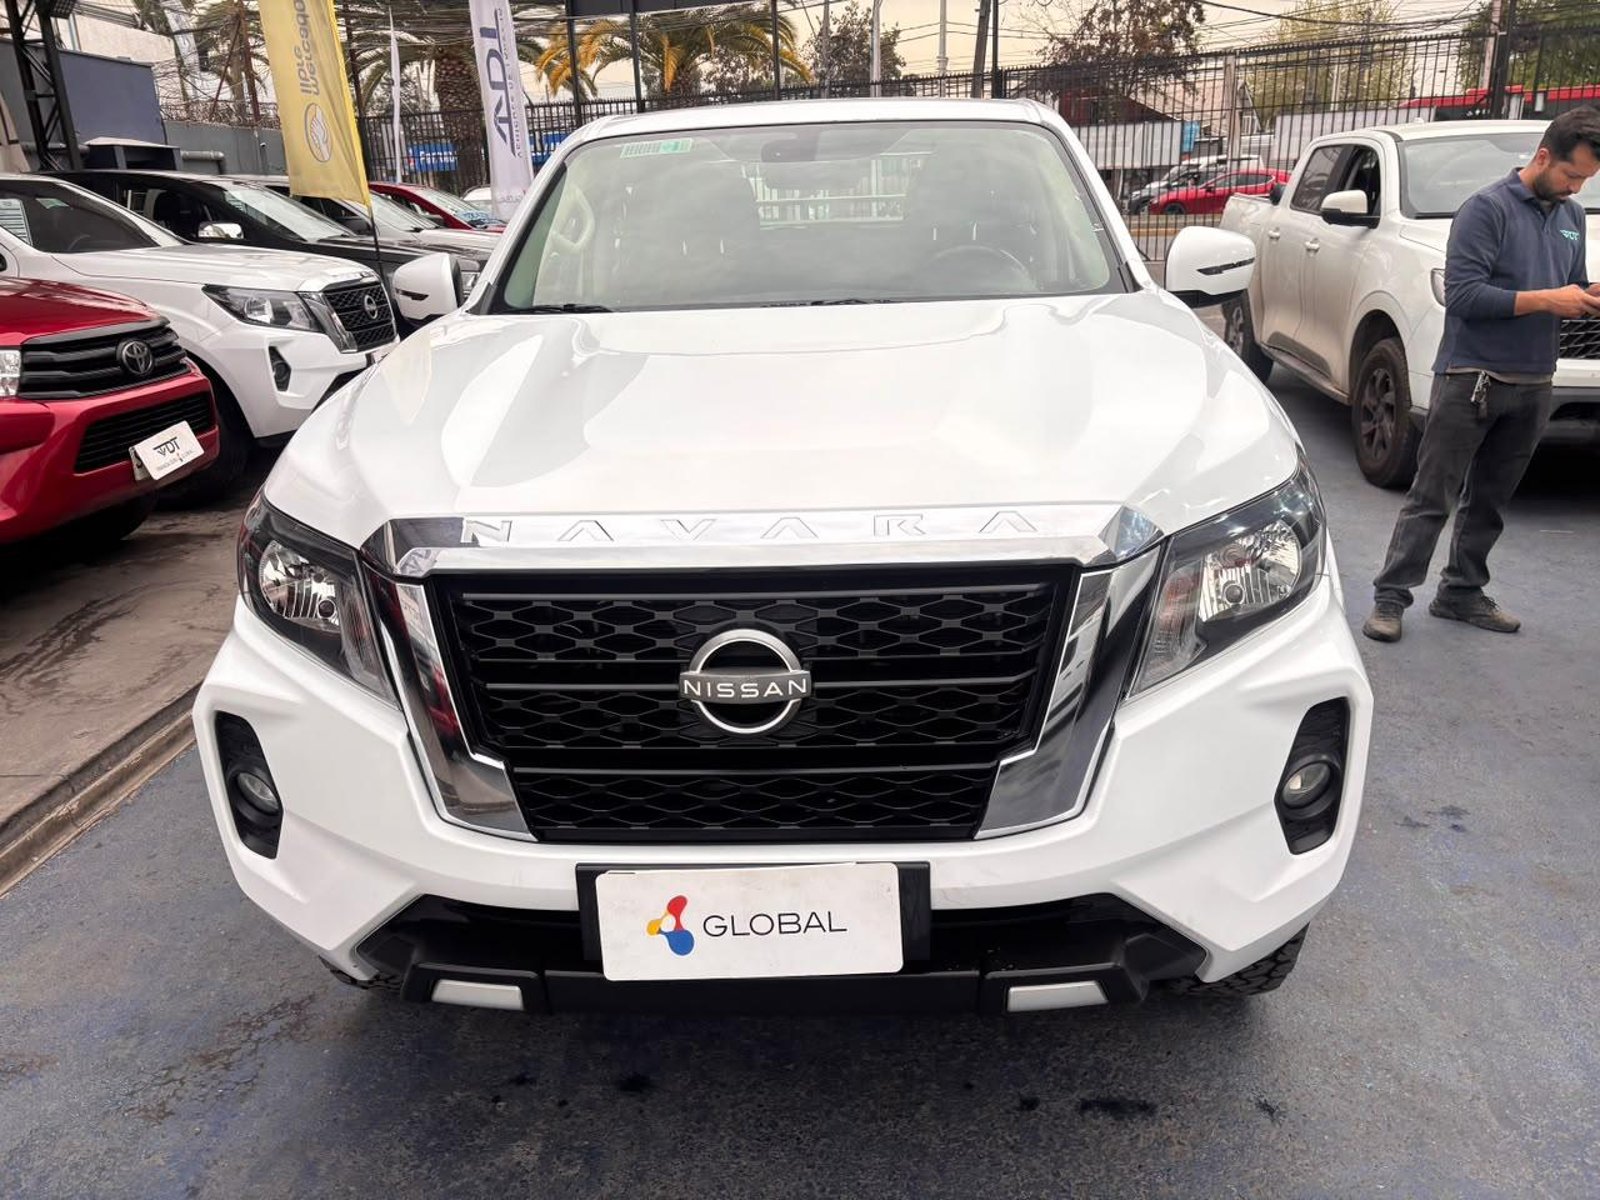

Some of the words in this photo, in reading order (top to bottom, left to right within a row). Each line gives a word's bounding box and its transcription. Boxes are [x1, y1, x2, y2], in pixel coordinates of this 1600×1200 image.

[479, 9, 516, 158] ADL
[460, 510, 1038, 544] NAVARA
[683, 678, 807, 698] NISSAN
[702, 911, 848, 937] GLOBAL
